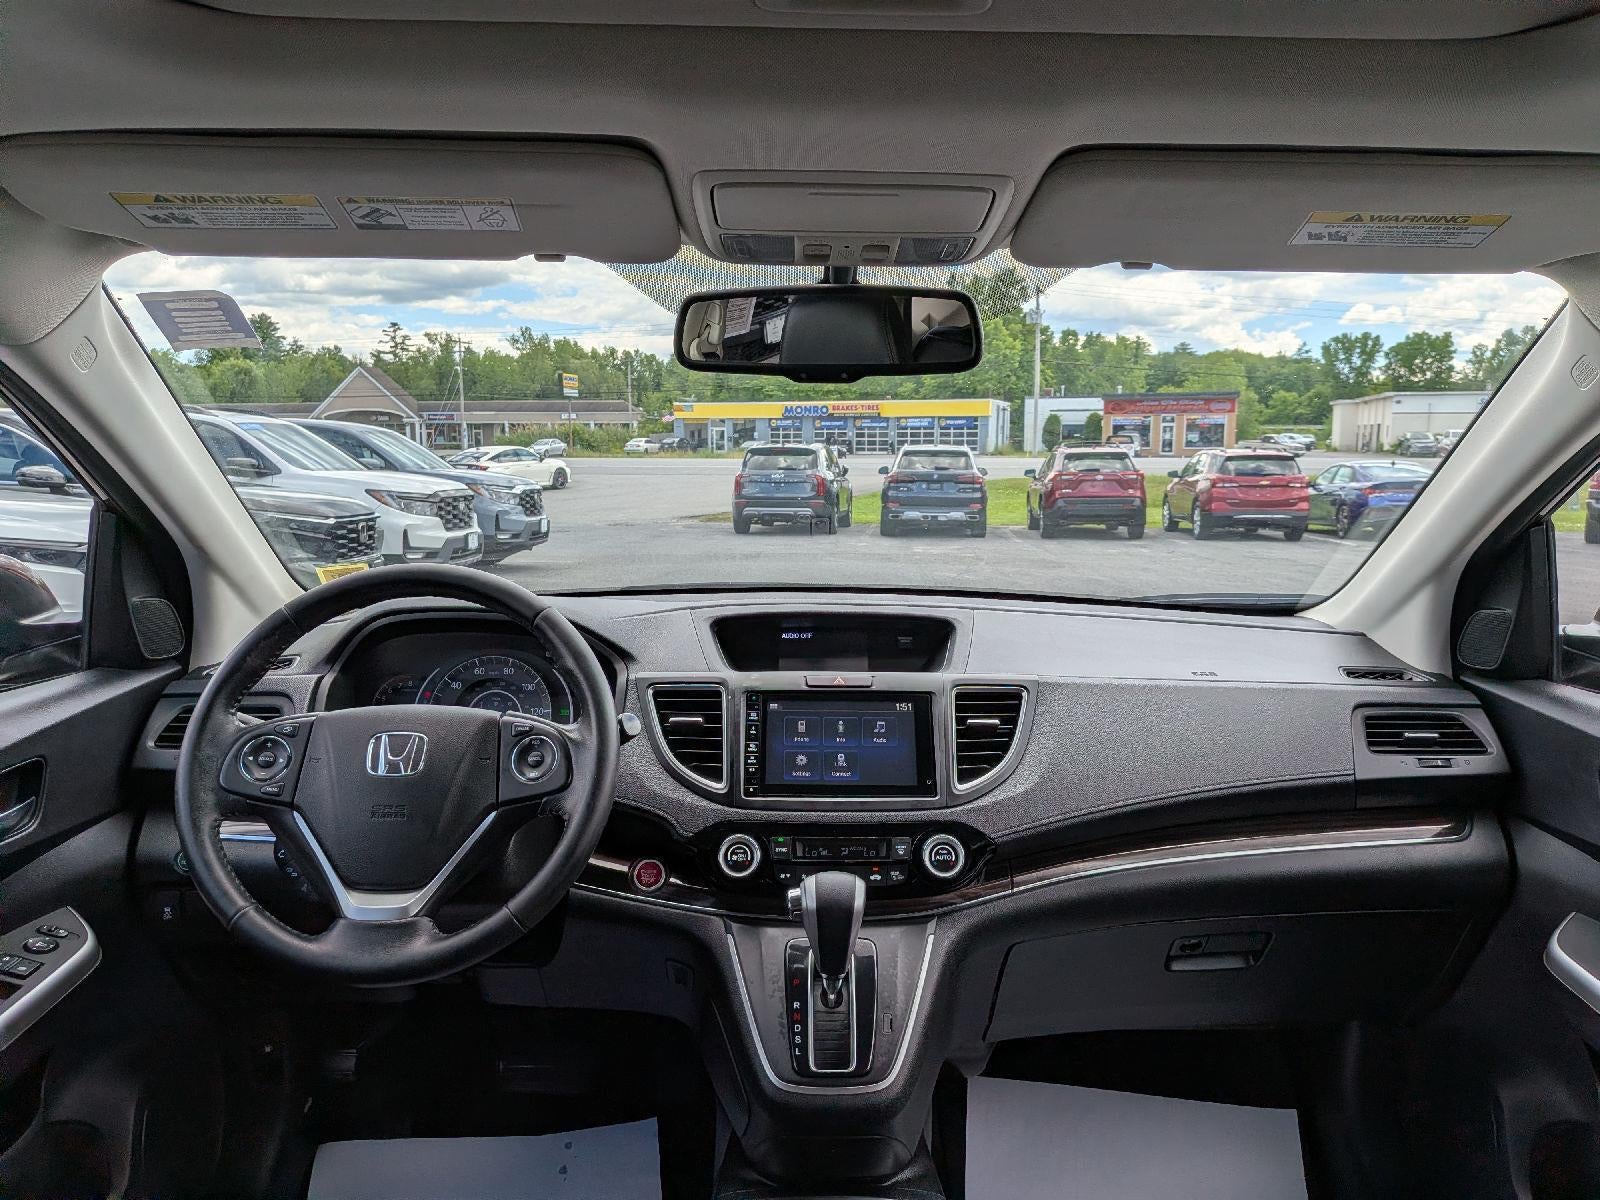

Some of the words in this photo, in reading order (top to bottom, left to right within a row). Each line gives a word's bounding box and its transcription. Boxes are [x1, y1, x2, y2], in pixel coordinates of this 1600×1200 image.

[175, 195, 284, 205] WARNING
[1368, 214, 1473, 225] WARNING
[783, 405, 829, 417] MONRO
[474, 667, 485, 676] 60
[503, 667, 514, 675] 80
[451, 681, 462, 690] 40
[522, 683, 536, 691] 100
[895, 702, 913, 711] 1:51
[530, 707, 544, 716] 120
[794, 1024, 802, 1032] D
[795, 1036, 802, 1044] S
